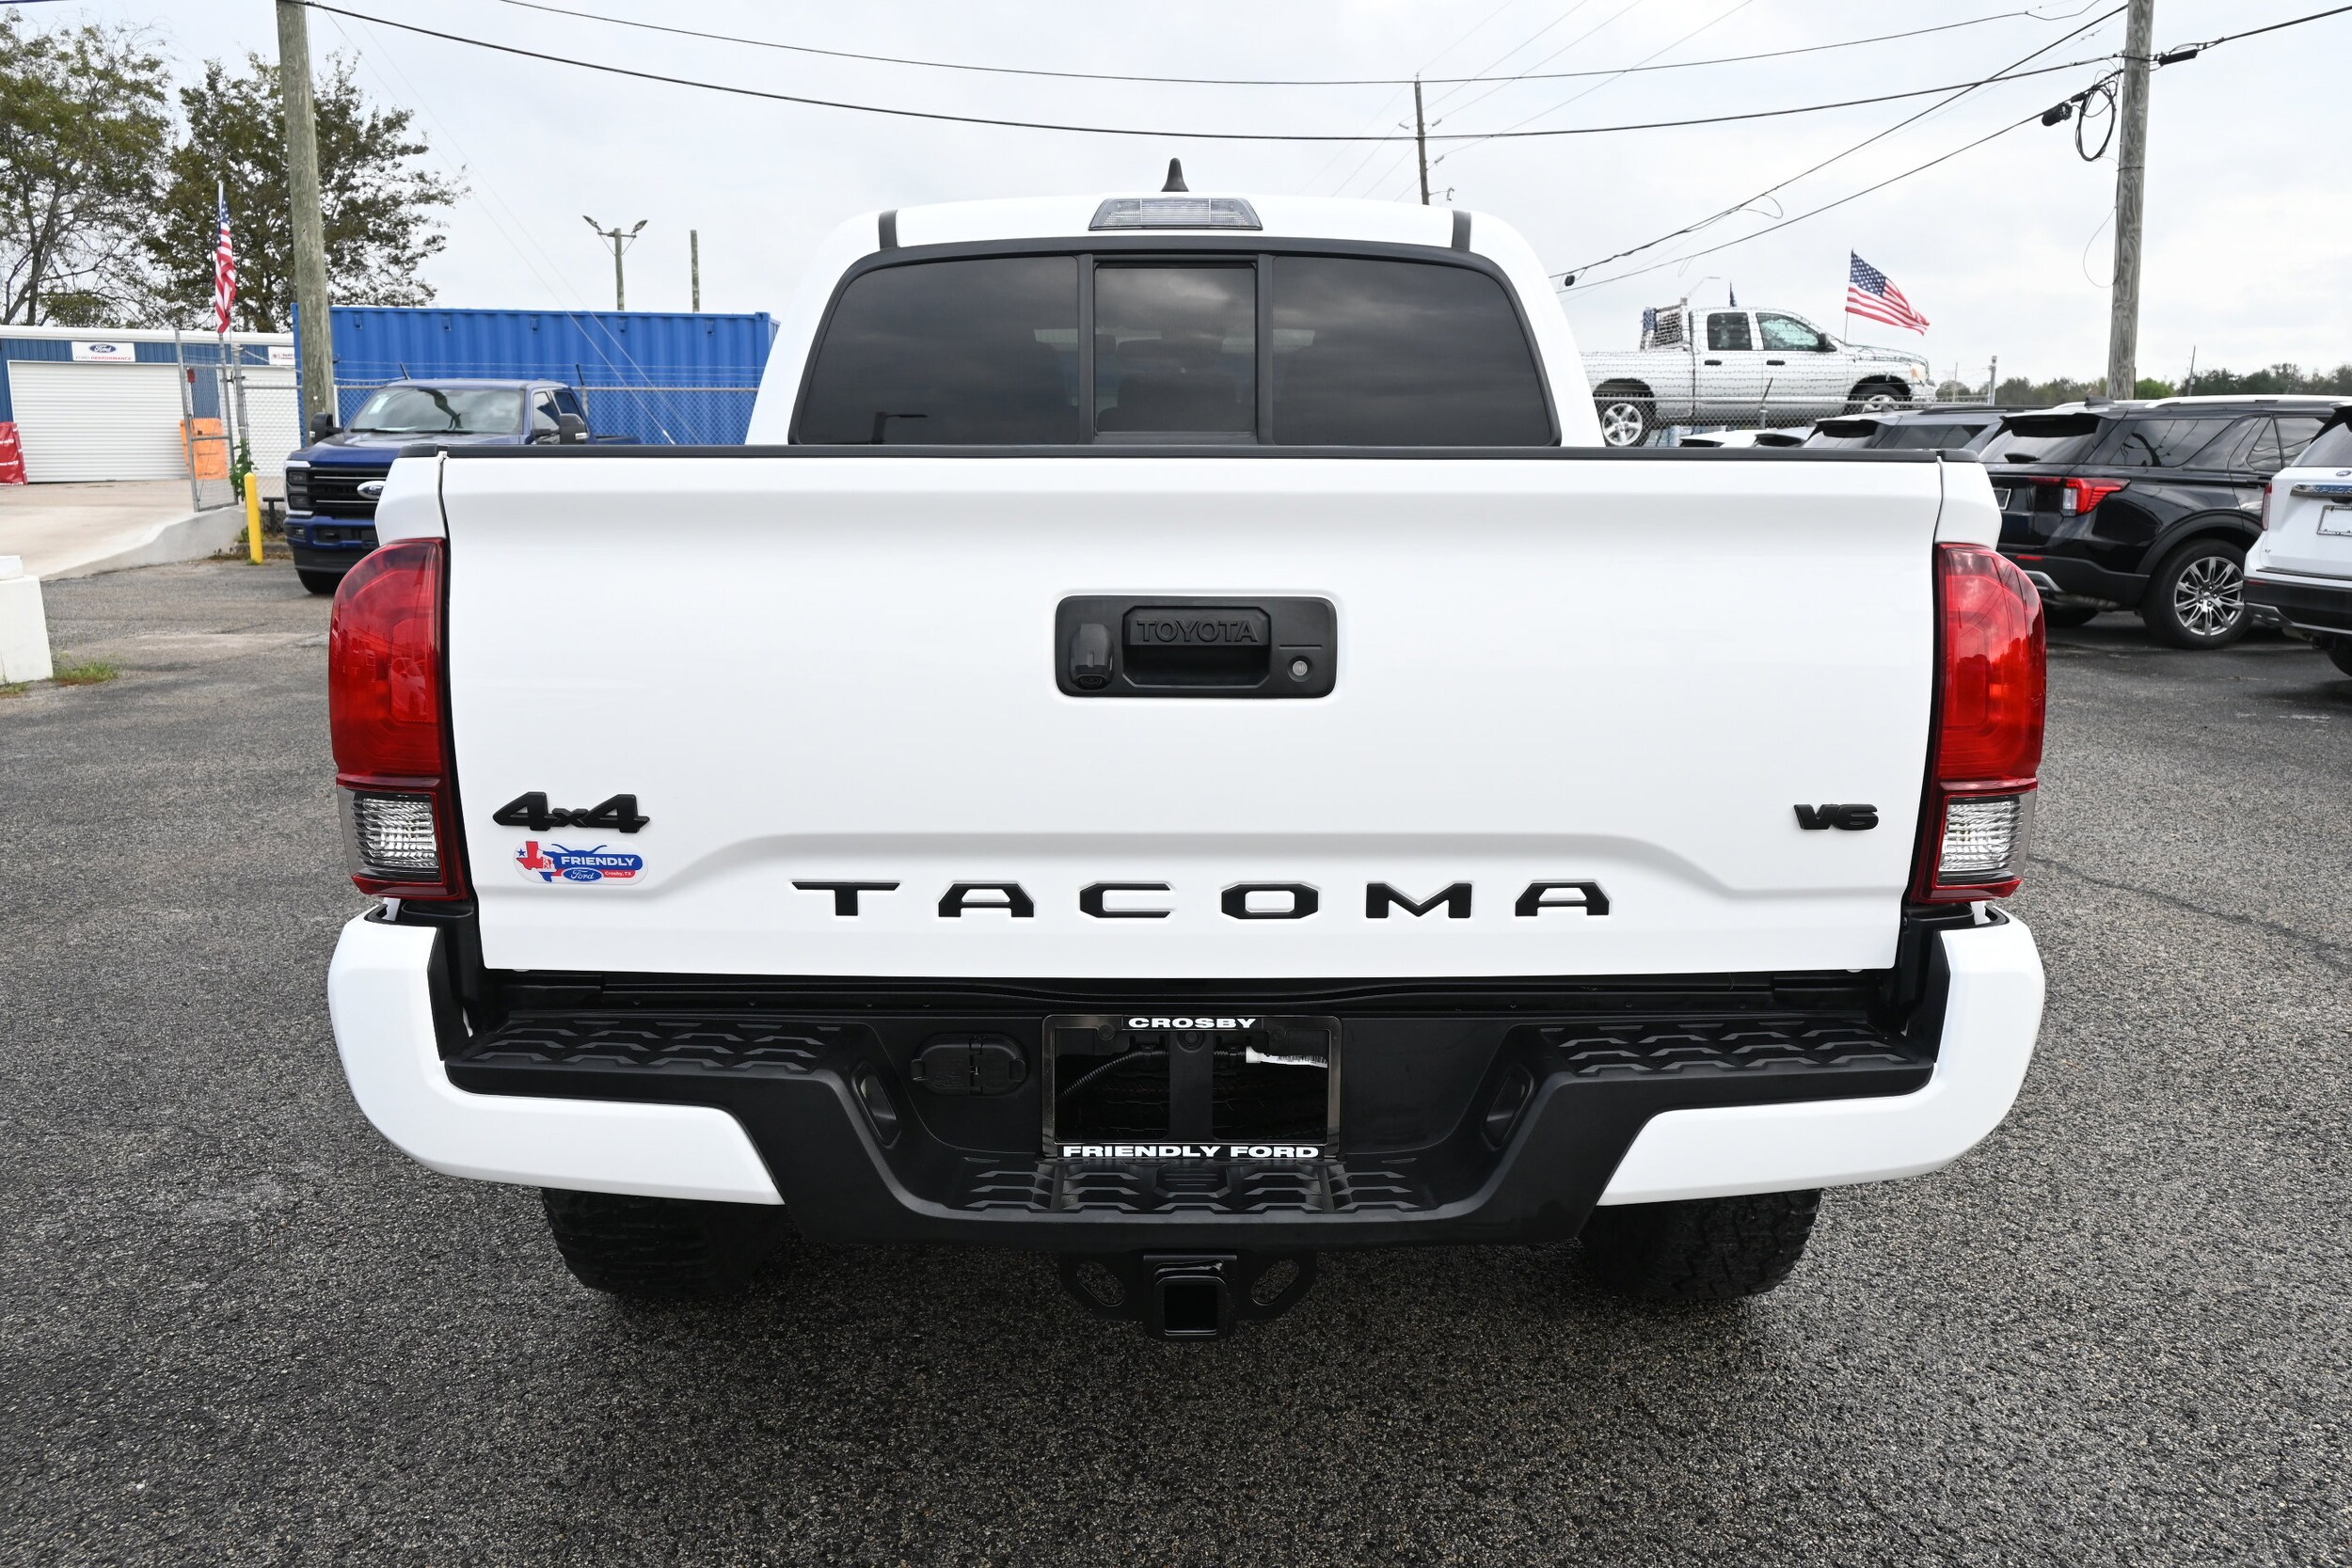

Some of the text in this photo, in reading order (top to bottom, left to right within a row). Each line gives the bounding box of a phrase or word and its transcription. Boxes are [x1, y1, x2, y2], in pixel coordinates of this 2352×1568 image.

[1136, 619, 1259, 642] TOYOTA
[493, 791, 650, 833] 4x4
[1793, 803, 1879, 831] V6
[561, 856, 635, 866] FRIENDLY
[570, 869, 595, 879] Ford
[792, 881, 1610, 920] TACOMA
[1128, 1017, 1257, 1029] CROSBY
[1063, 1145, 1319, 1158] FRIENDLY FORD
